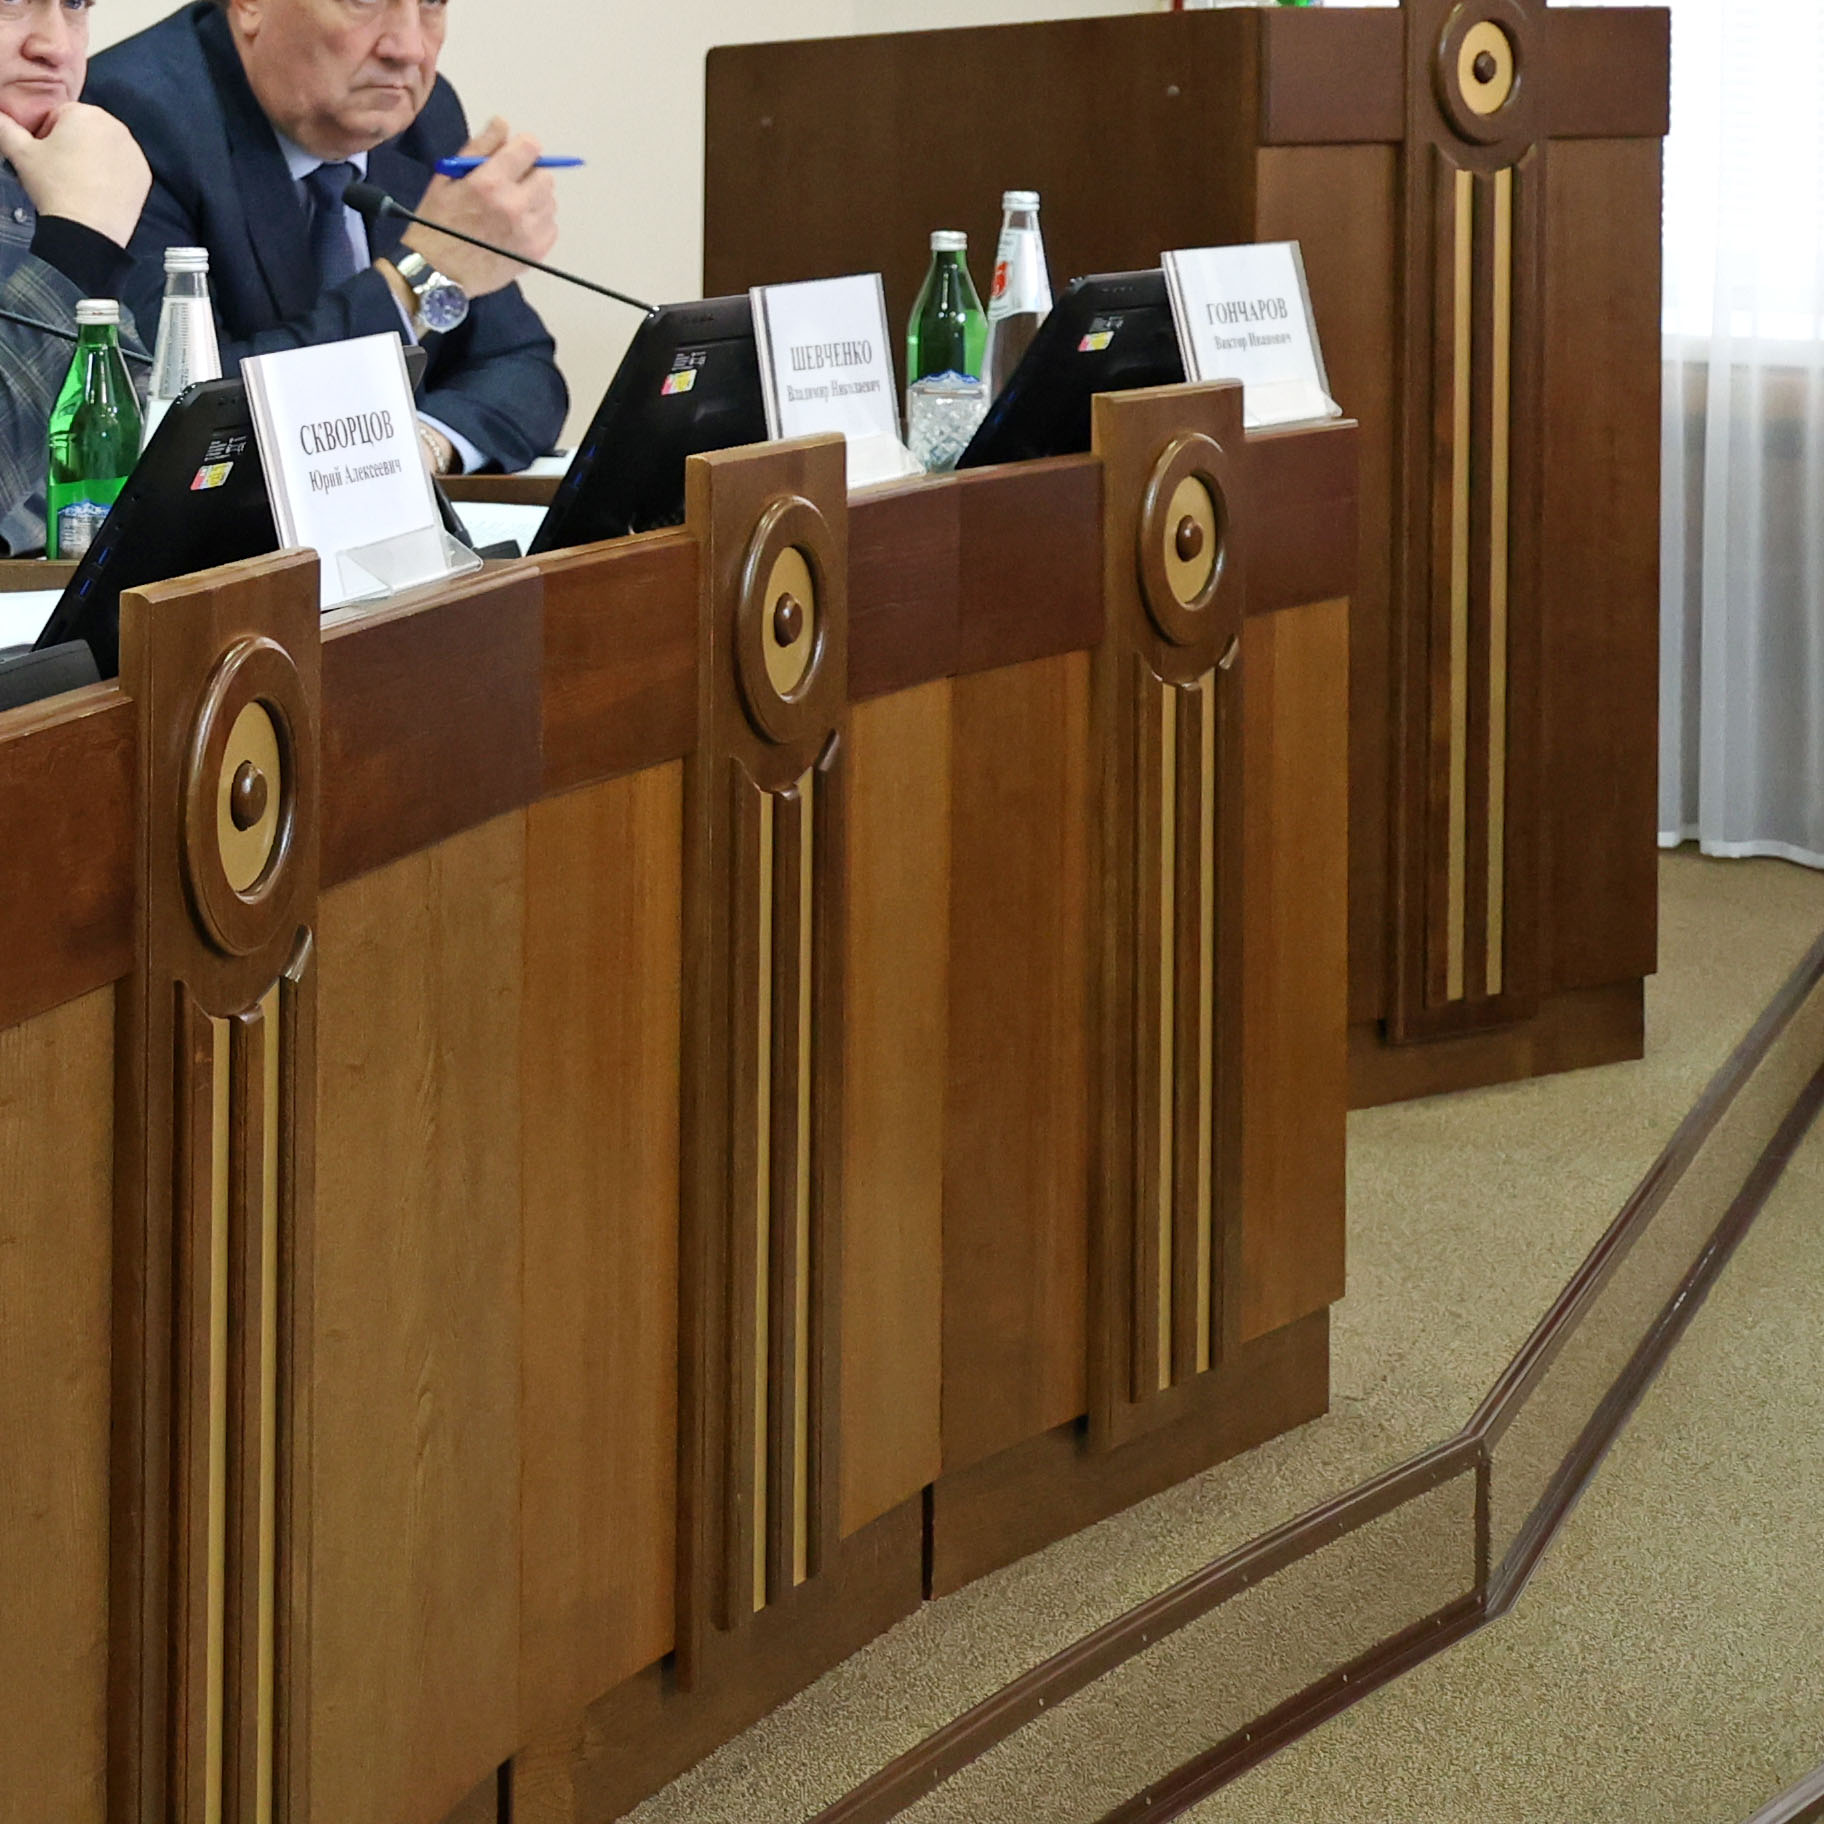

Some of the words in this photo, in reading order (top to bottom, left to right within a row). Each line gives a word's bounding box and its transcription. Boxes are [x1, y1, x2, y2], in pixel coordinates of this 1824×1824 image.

[1206, 297, 1289, 326] ГОНЧАРОВ
[790, 339, 873, 371] ШЕВЧЕНКО
[299, 410, 395, 456] СКВОРЦОВ
[309, 465, 343, 495] Юрий
[345, 459, 402, 485] Алексеевич
